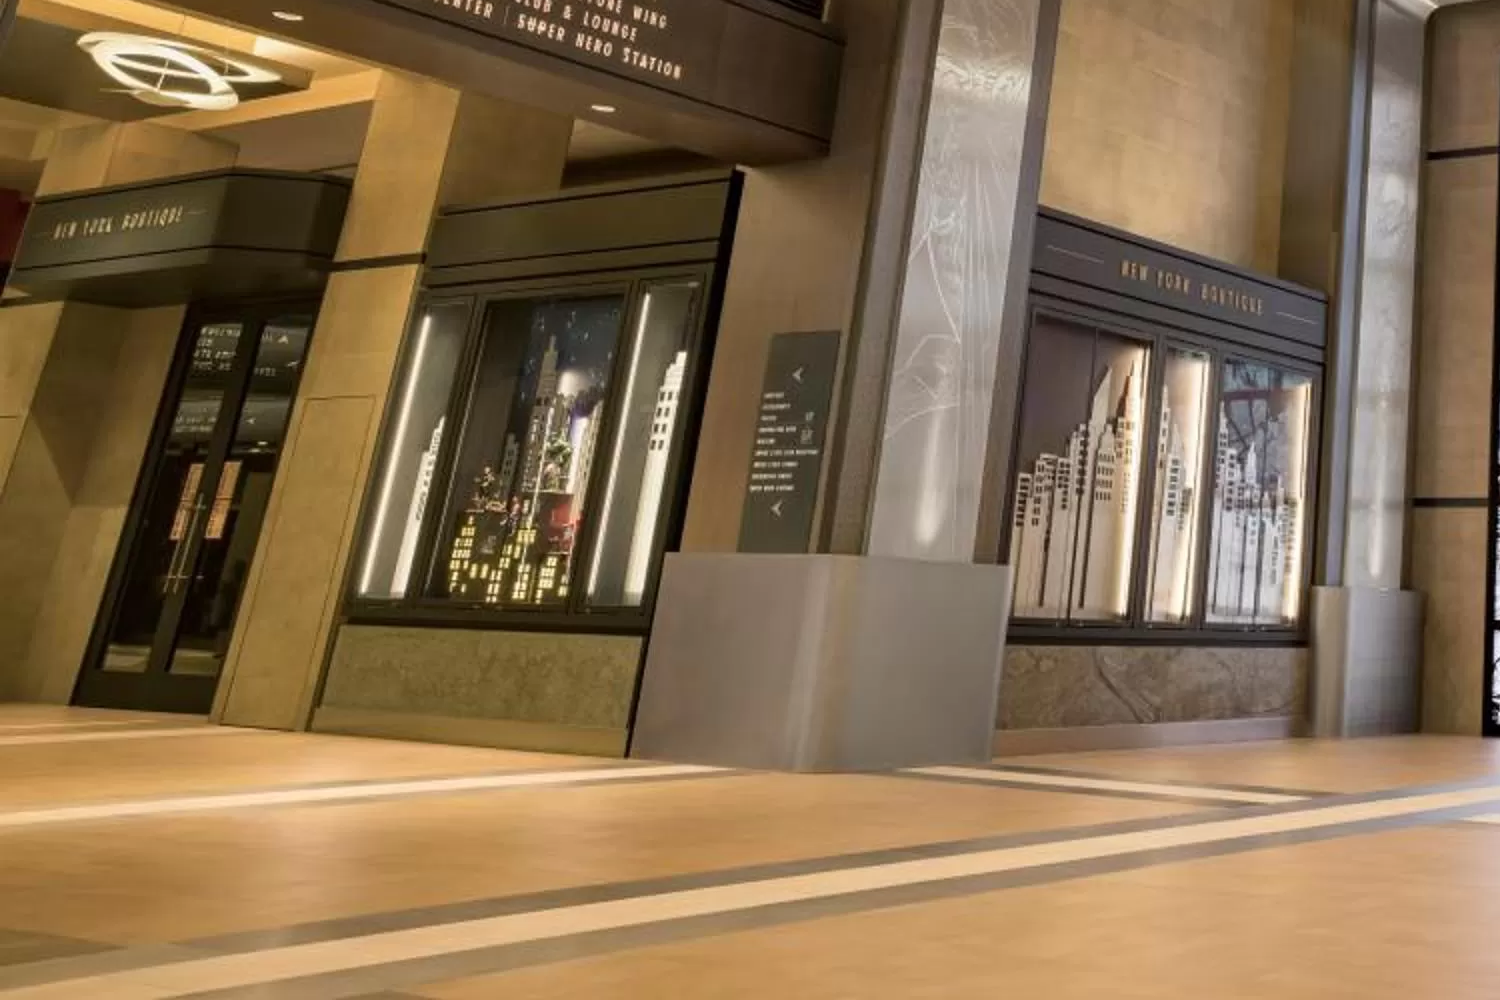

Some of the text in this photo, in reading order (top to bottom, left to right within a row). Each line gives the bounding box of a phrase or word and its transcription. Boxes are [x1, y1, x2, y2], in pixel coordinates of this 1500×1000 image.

[563, 5, 573, 20] &
[583, 11, 638, 42] LOUNGE
[633, 5, 668, 29] WING
[517, 14, 566, 42] SUPER
[575, 33, 613, 57] HERO
[623, 47, 682, 79] STATION
[1120, 259, 1264, 316] NEW YORK BOUTIQUE
